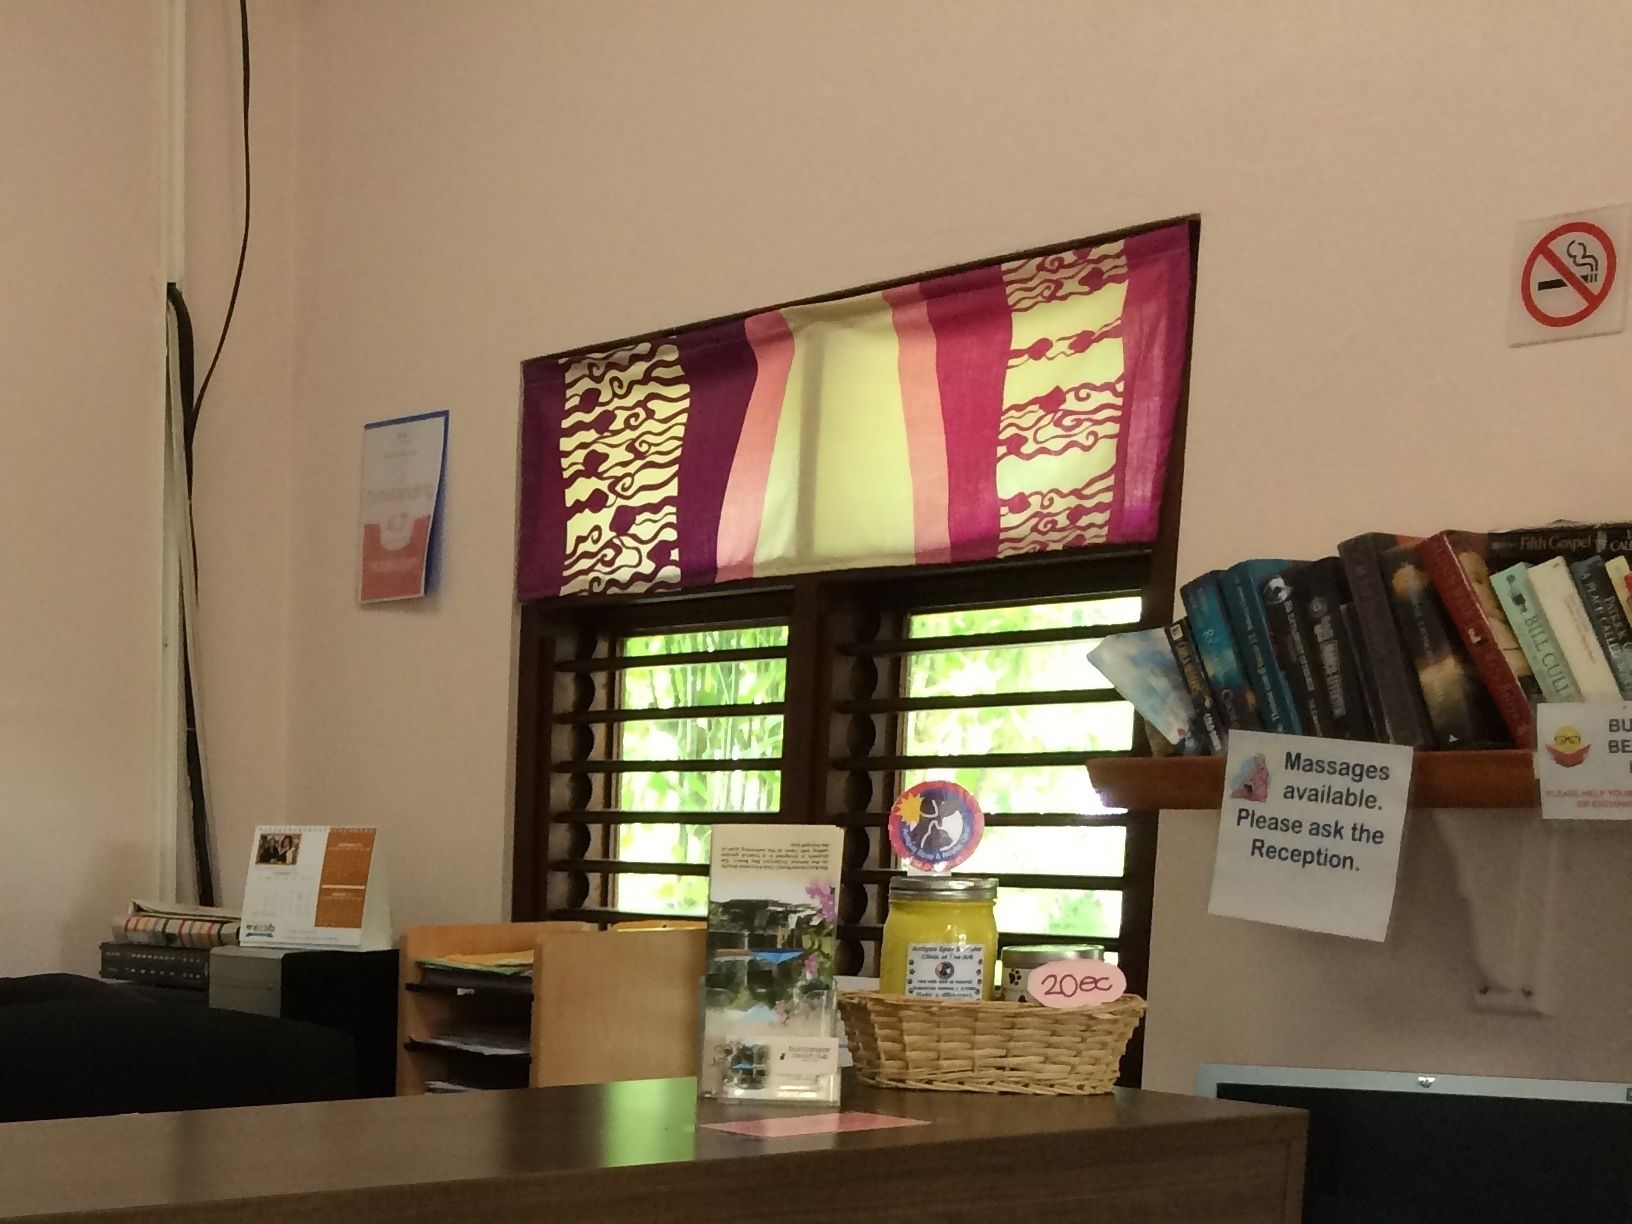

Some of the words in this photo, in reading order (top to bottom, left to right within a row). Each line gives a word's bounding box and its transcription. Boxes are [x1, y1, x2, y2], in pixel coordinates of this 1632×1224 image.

[1524, 613, 1549, 652] BILL
[1284, 751, 1391, 783] Massages
[1283, 784, 1383, 811] available.
[1236, 808, 1304, 834] Please
[1308, 819, 1345, 840] ask
[1351, 822, 1385, 845] the
[1250, 838, 1361, 872] Reception.
